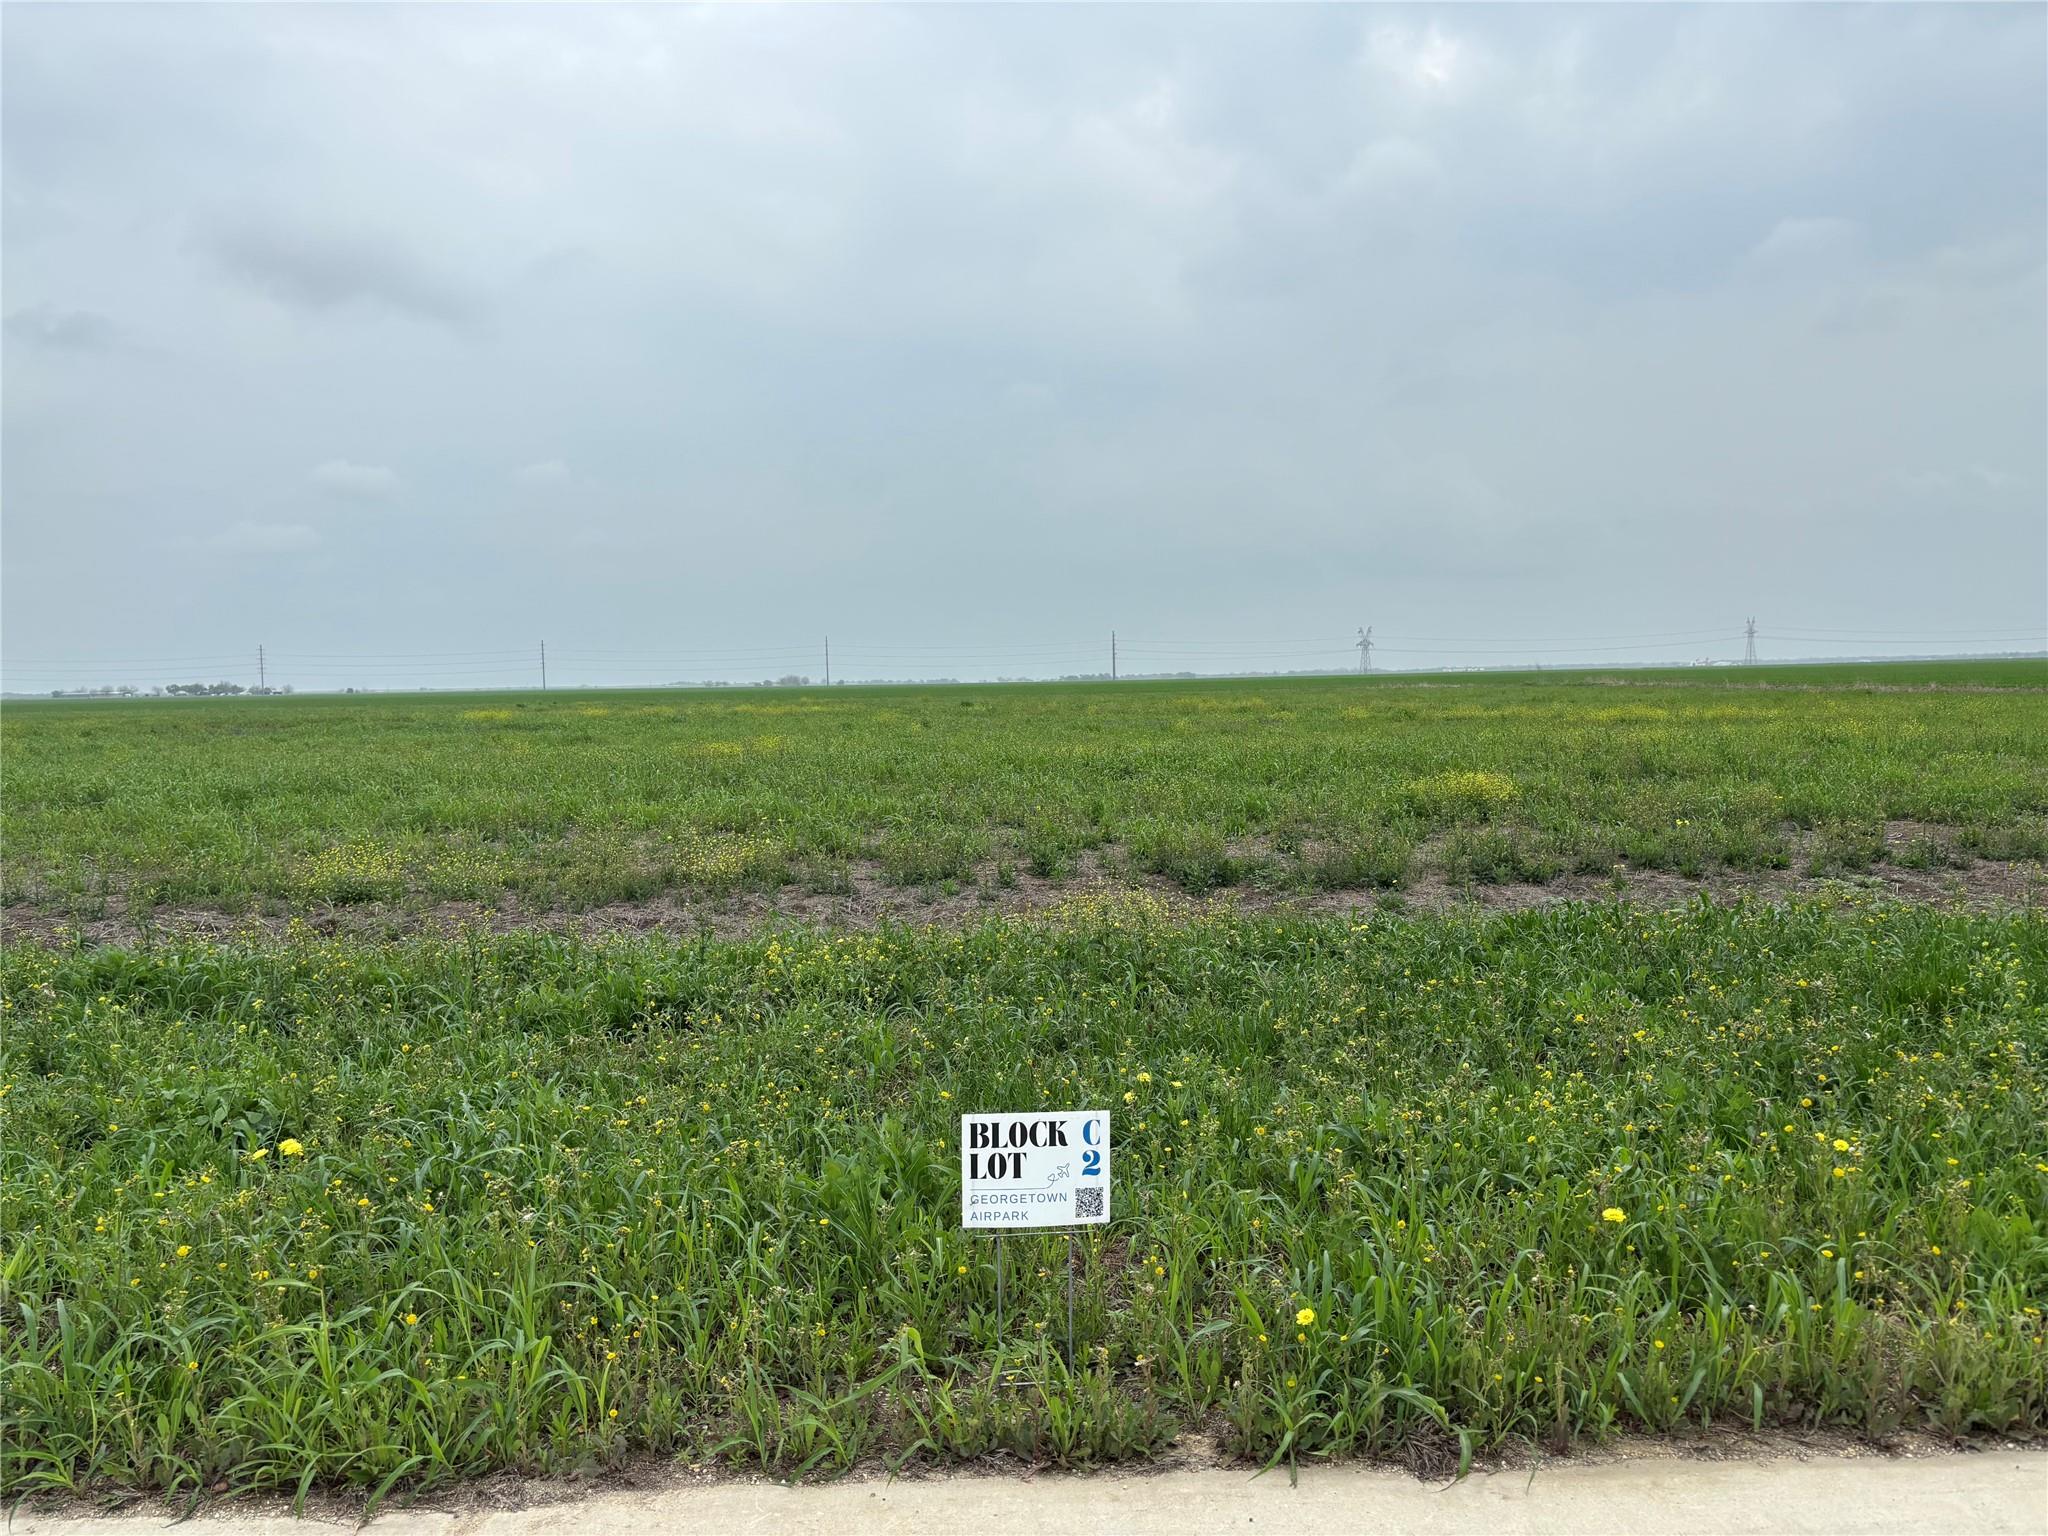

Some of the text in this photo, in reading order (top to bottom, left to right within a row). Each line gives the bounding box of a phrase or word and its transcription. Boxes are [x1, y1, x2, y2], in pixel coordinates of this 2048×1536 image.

[969, 1119, 1101, 1149] BLOCK C
[969, 1149, 1101, 1180] LOT 2
[969, 1192, 1068, 1205] GEORGETOWN
[969, 1210, 1029, 1221] AIRPARK
